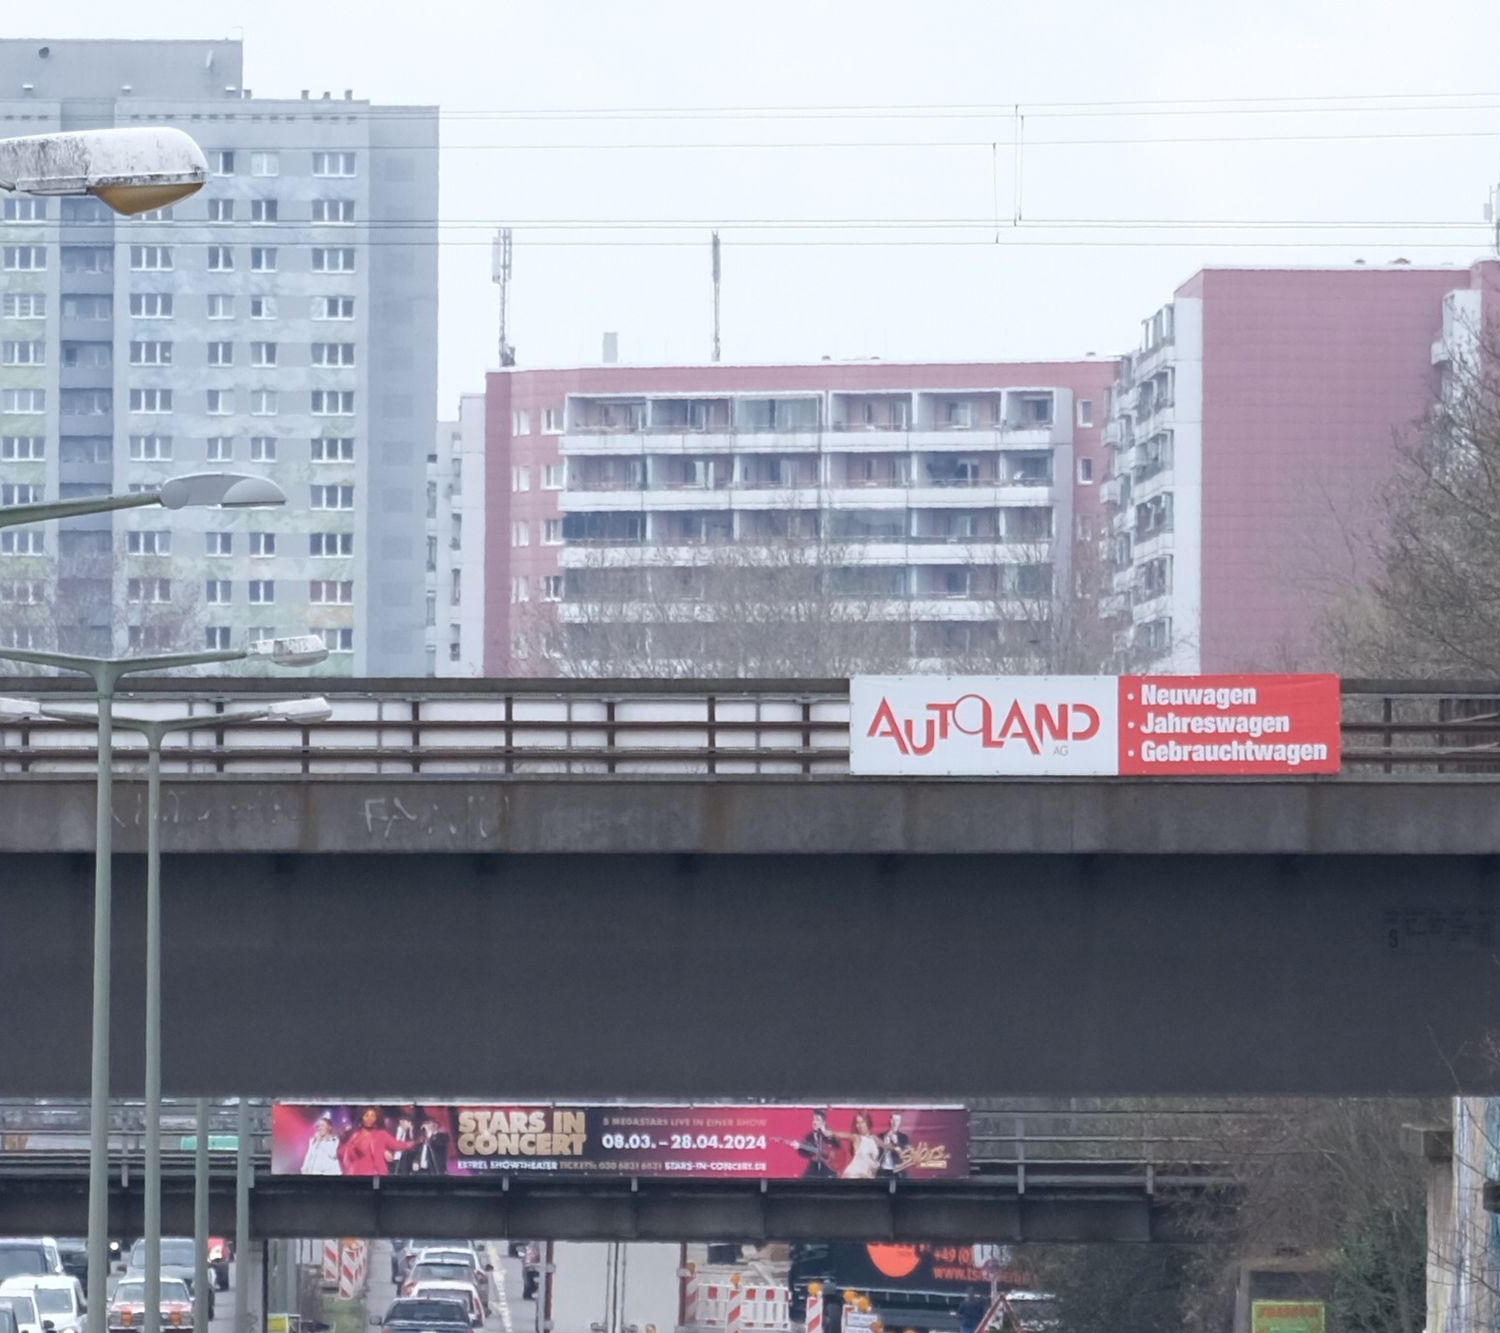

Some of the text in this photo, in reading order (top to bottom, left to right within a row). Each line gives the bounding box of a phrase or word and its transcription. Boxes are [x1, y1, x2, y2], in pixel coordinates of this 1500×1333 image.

[1141, 684, 1257, 707] Neuwagen
[867, 694, 1100, 755] AUTOLAND
[1141, 712, 1290, 736] Jahreswagen
[1141, 740, 1328, 764] Gebrauchtwagen
[458, 1111, 586, 1133] STARS IN
[457, 1134, 587, 1155] CONCERT
[602, 1134, 656, 1149] 08.03.
[671, 1134, 767, 1149] 28.04.2024
